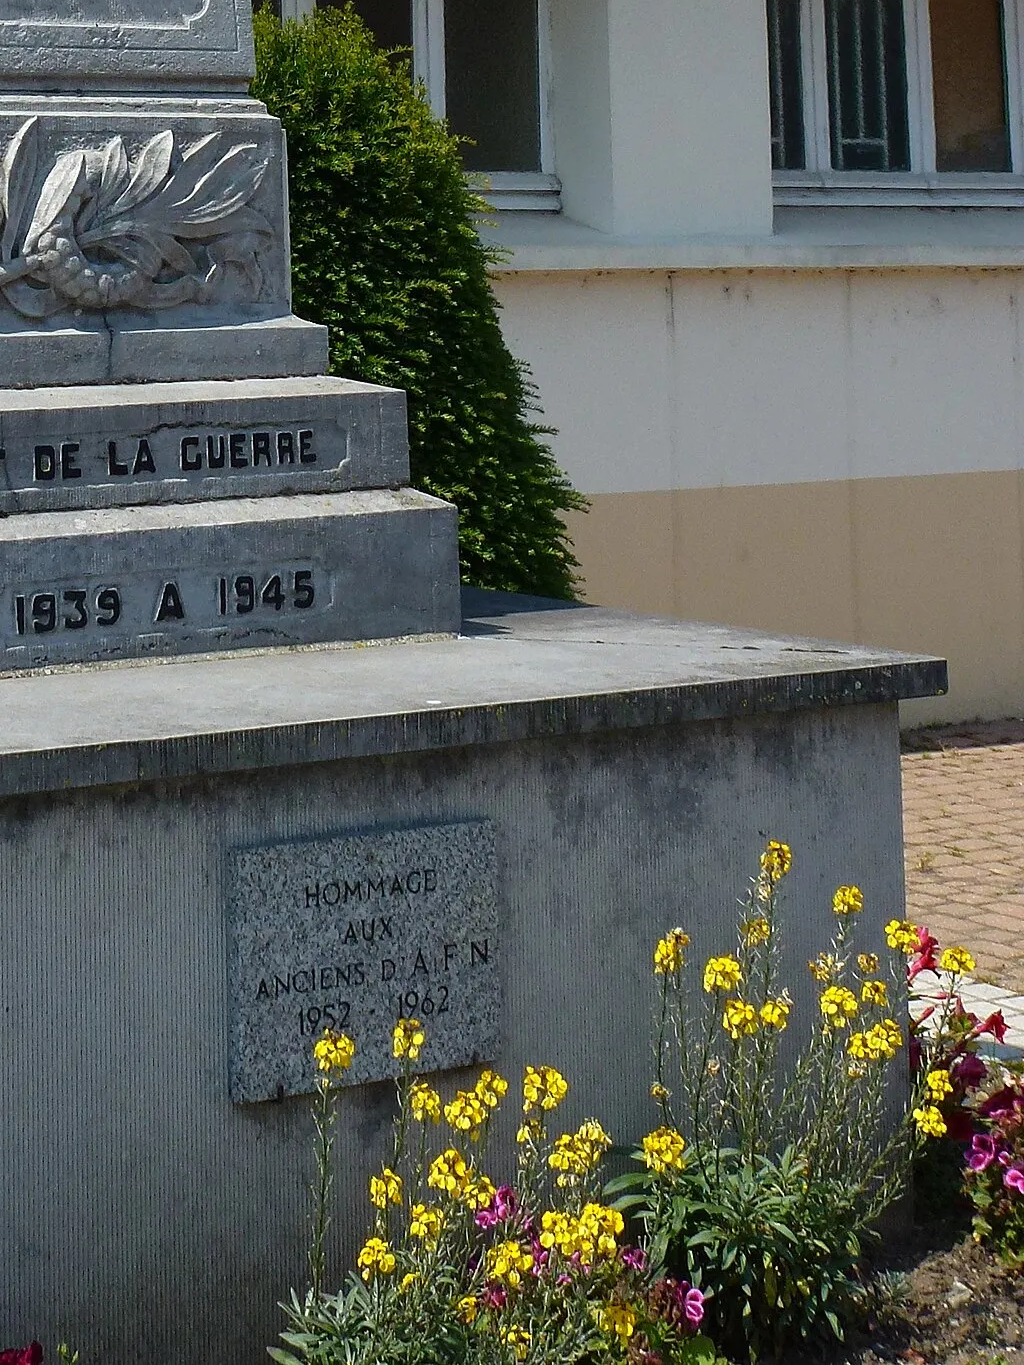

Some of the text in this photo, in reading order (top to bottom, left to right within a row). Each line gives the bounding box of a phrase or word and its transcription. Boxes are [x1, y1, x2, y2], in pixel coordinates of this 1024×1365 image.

[33, 442, 81, 481] DE
[107, 438, 156, 475] LA
[180, 429, 317, 471] GUERRE
[15, 570, 315, 634] 1939 A 1945
[305, 870, 437, 908] HOMMAGE
[343, 916, 393, 944] AUX
[256, 962, 365, 1000] ANCIENS
[298, 1001, 351, 1034] 1952
[398, 986, 449, 1018] 1962
